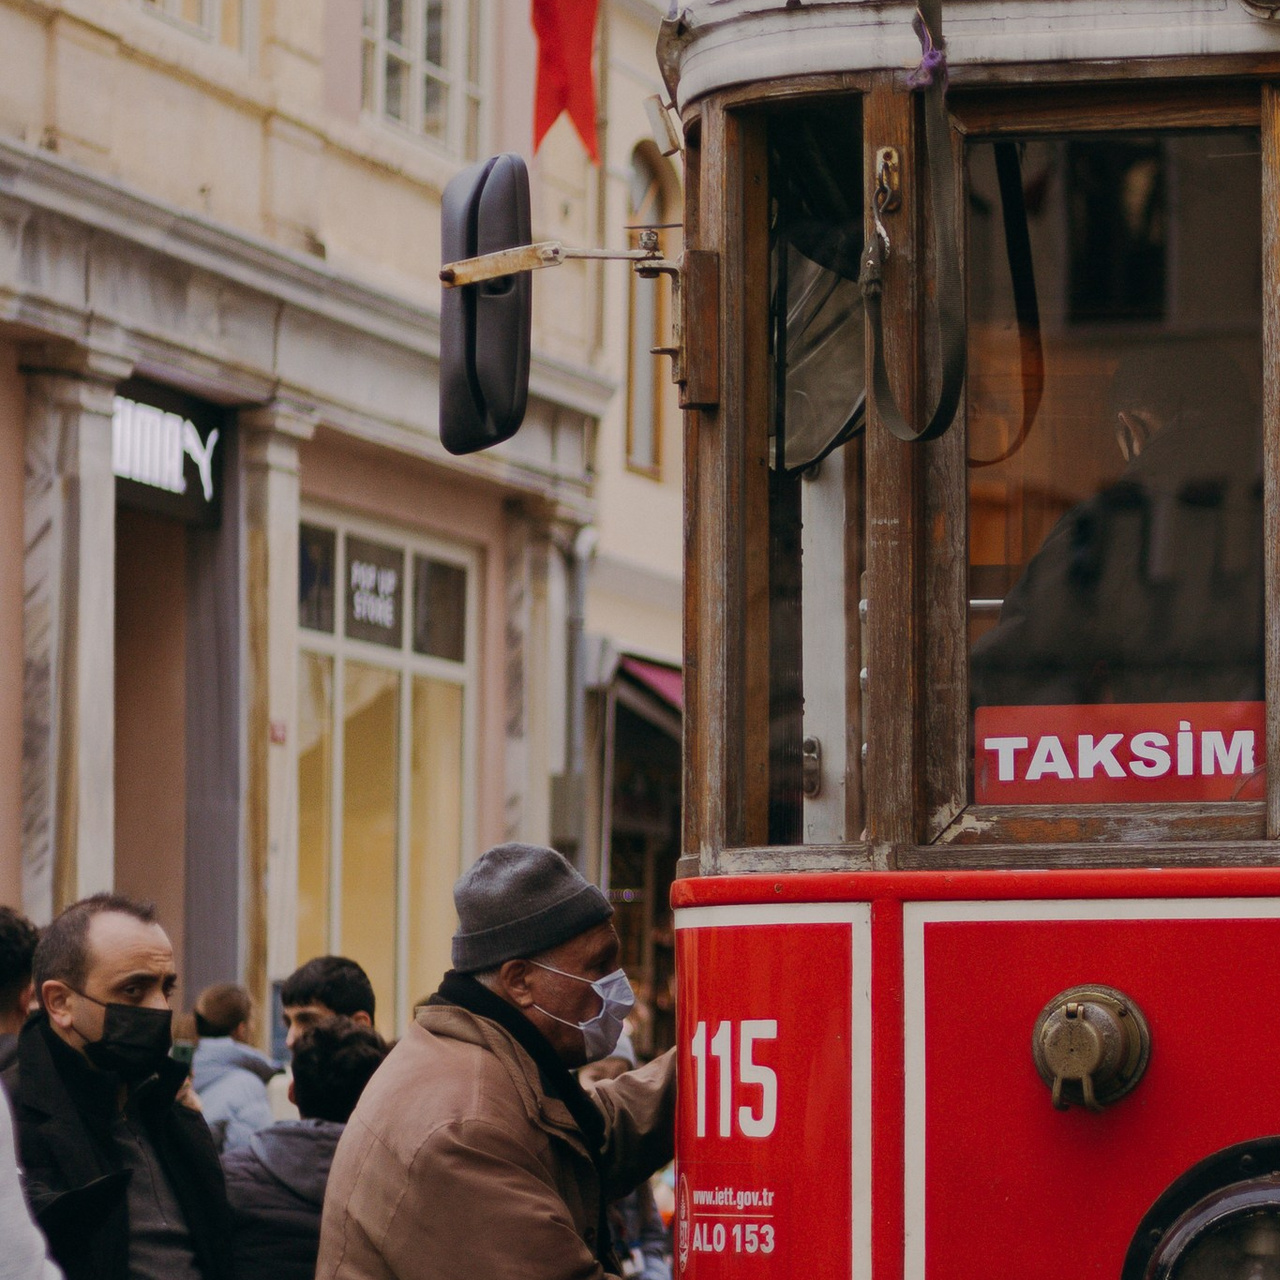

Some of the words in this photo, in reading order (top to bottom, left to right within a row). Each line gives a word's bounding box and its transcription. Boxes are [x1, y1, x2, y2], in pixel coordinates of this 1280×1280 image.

[984, 720, 1255, 782] TAKSİM
[691, 1019, 778, 1138] 115
[692, 1186, 775, 1210] www.iett.gov.tr
[692, 1222, 726, 1252] ALO
[732, 1224, 775, 1253] 153
